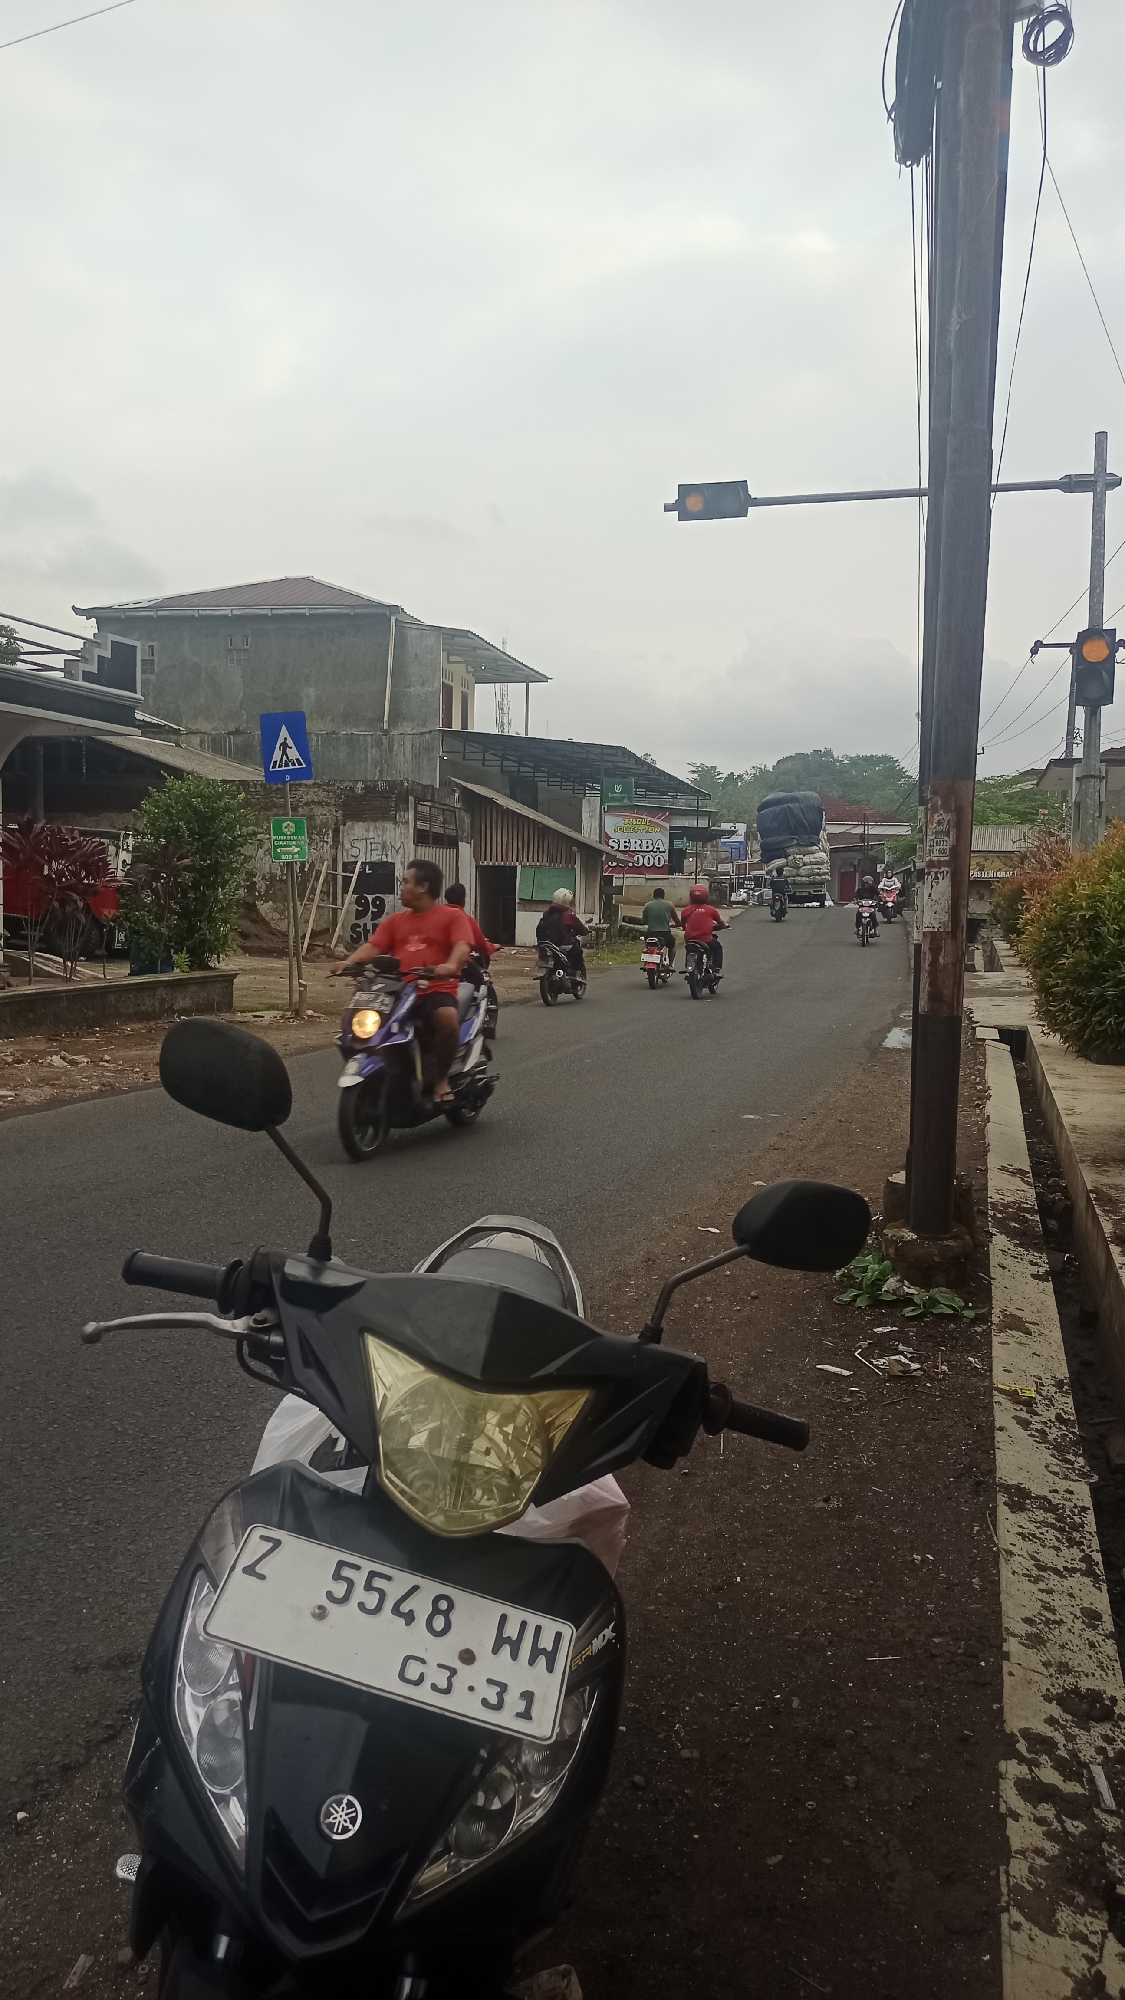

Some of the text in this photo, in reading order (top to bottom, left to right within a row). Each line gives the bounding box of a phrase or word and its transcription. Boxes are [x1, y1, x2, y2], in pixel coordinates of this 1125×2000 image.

[608, 838, 666, 852] SERBA
[354, 893, 386, 922] 99
[242, 1534, 563, 1674] Z 5548 WW
